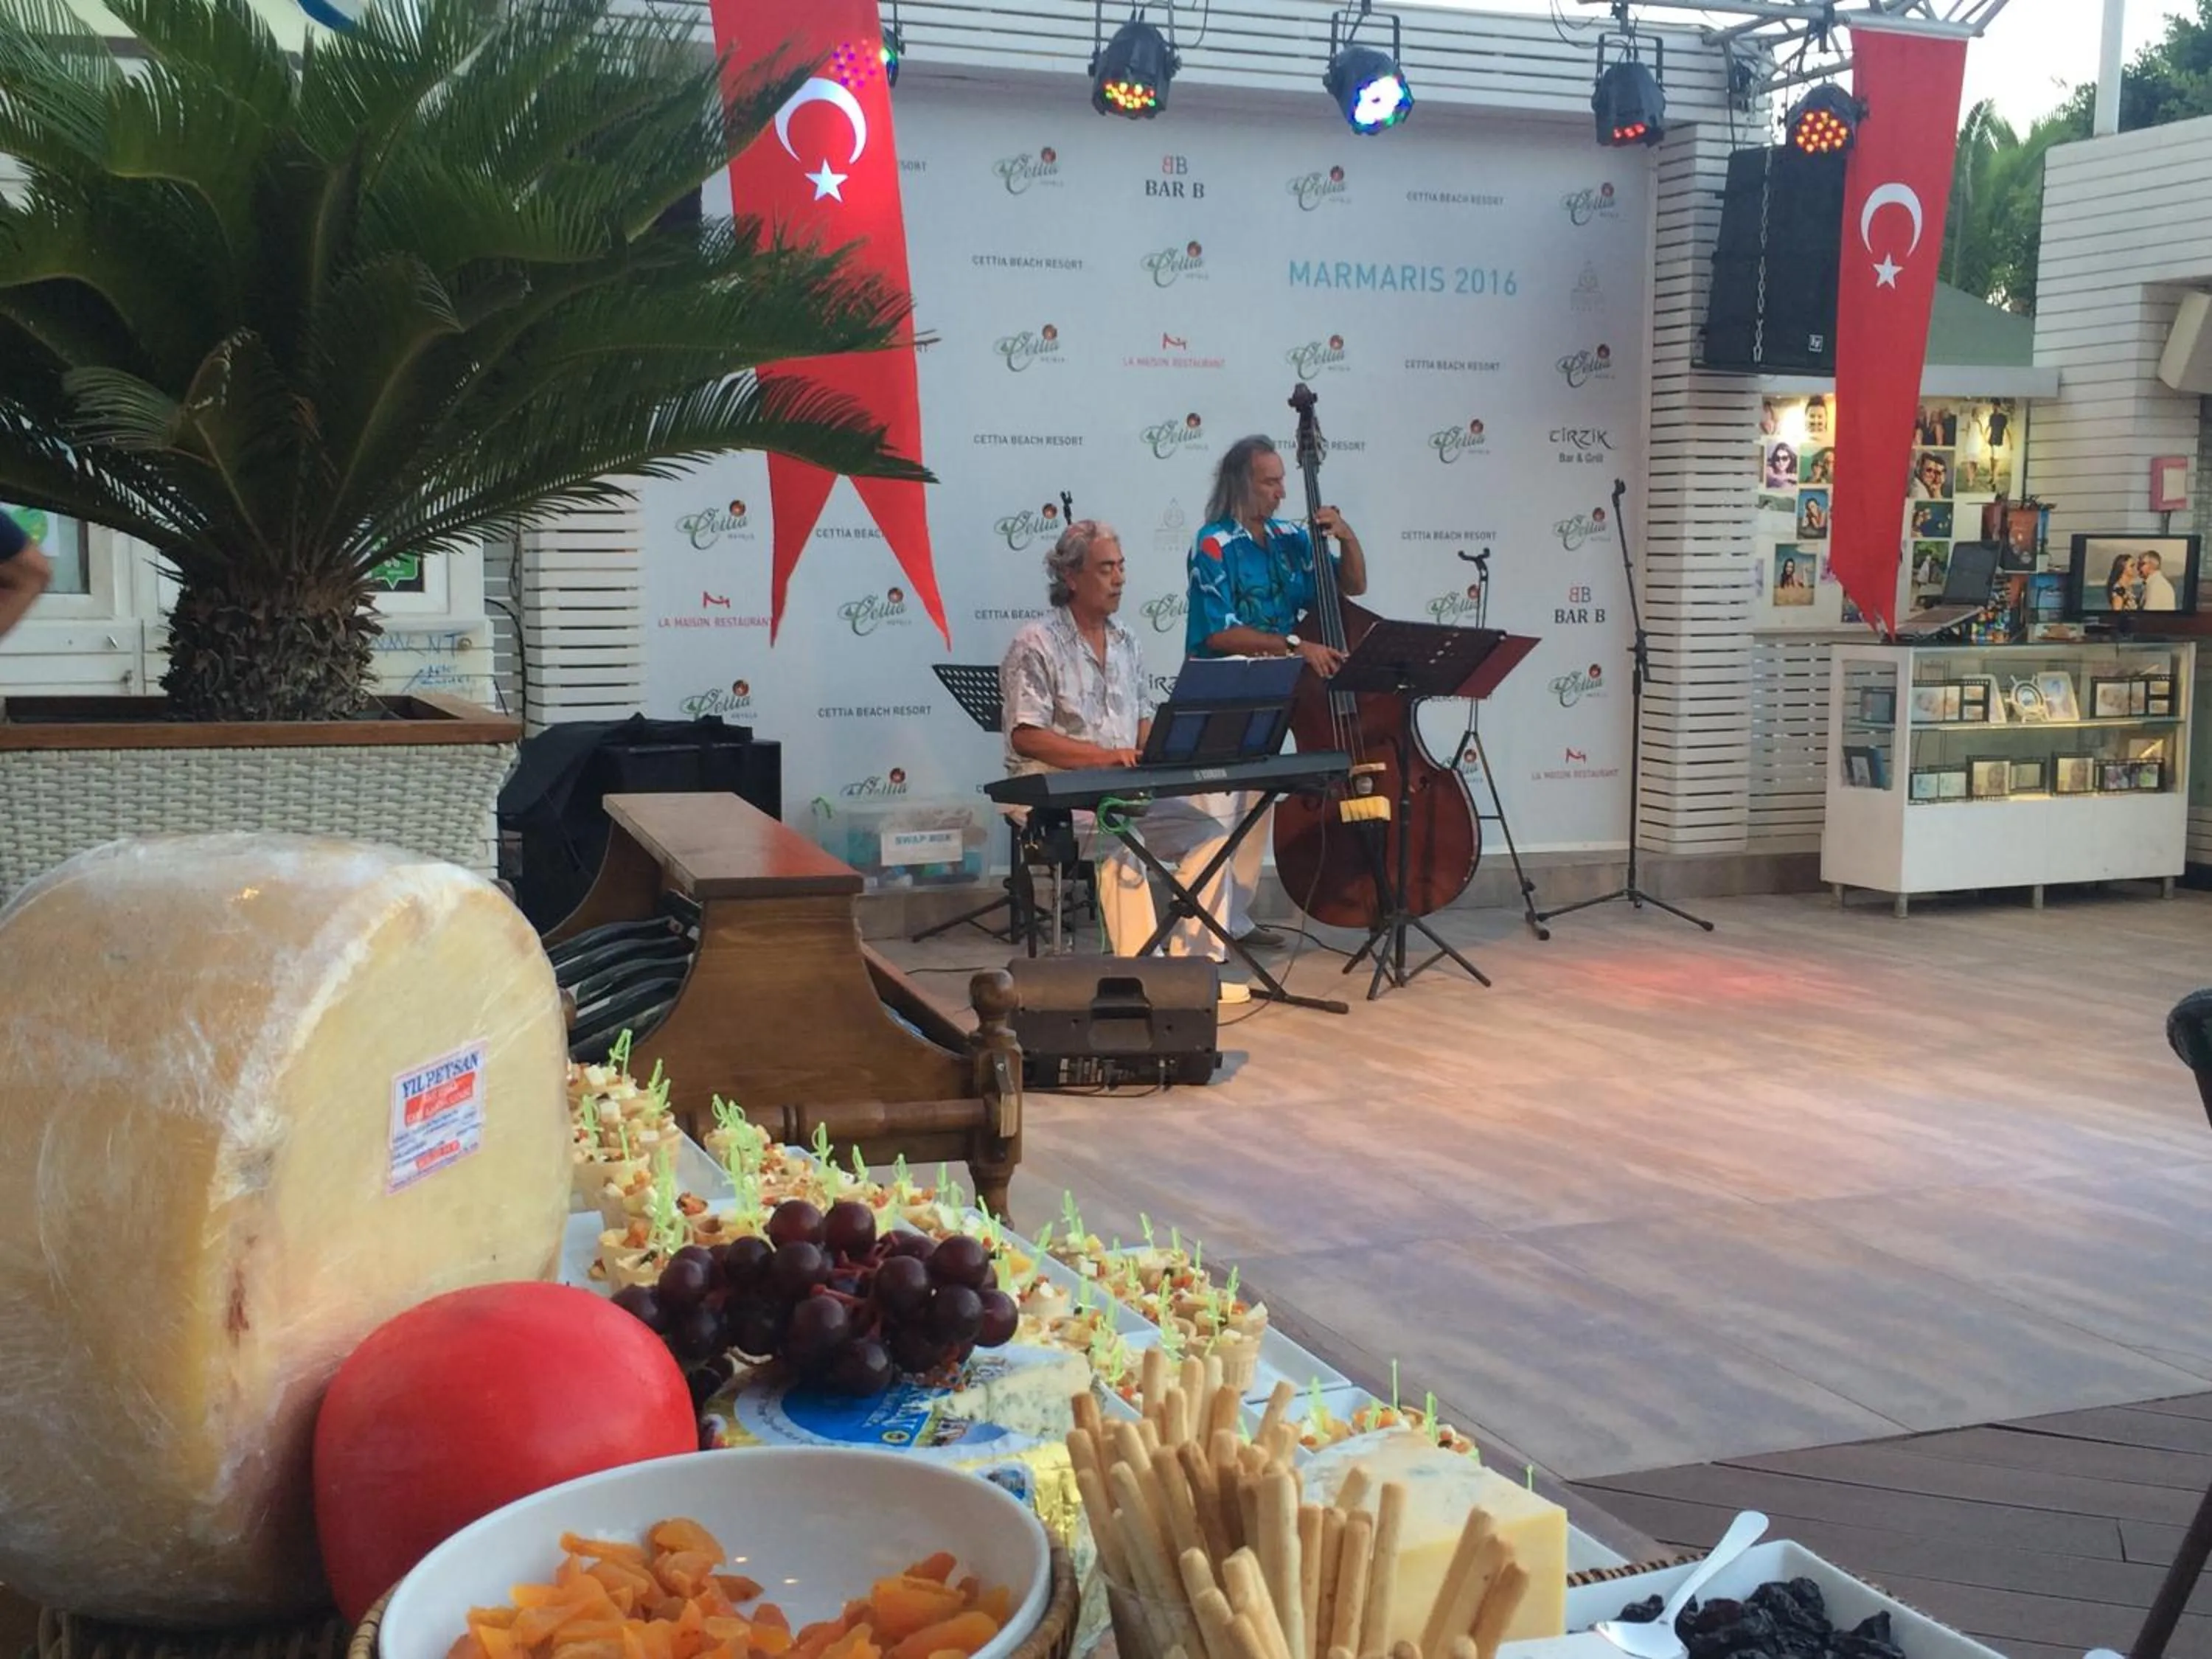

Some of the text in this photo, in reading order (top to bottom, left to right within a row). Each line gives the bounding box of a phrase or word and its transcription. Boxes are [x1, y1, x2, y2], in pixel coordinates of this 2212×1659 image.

[900, 160, 927, 172] SORT
[1145, 180, 1204, 198] BAR B
[1407, 191, 1503, 206] CETTIA BEACH RESORT
[972, 255, 1083, 269] CETTIA BEACH RESORT
[1290, 260, 1517, 296] MARMARIS 2016
[1405, 359, 1500, 372] CETTIA BEACH RESORT
[973, 434, 1083, 445] CETTIA BEACH RESORT
[1332, 441, 1366, 451] RESORT
[1559, 453, 1573, 462] Bar
[816, 528, 885, 538] CETTIA BEAC
[1401, 531, 1497, 540] CETTIA BEACH RESORT
[975, 610, 1009, 620] CETTIA
[1011, 609, 1043, 619] BEACH
[1554, 608, 1605, 624] BAR B
[658, 617, 670, 627] LA
[675, 616, 710, 627] MAISON
[818, 706, 932, 718] CETTIA BEACH RESORT
[895, 833, 927, 845] SWAP
